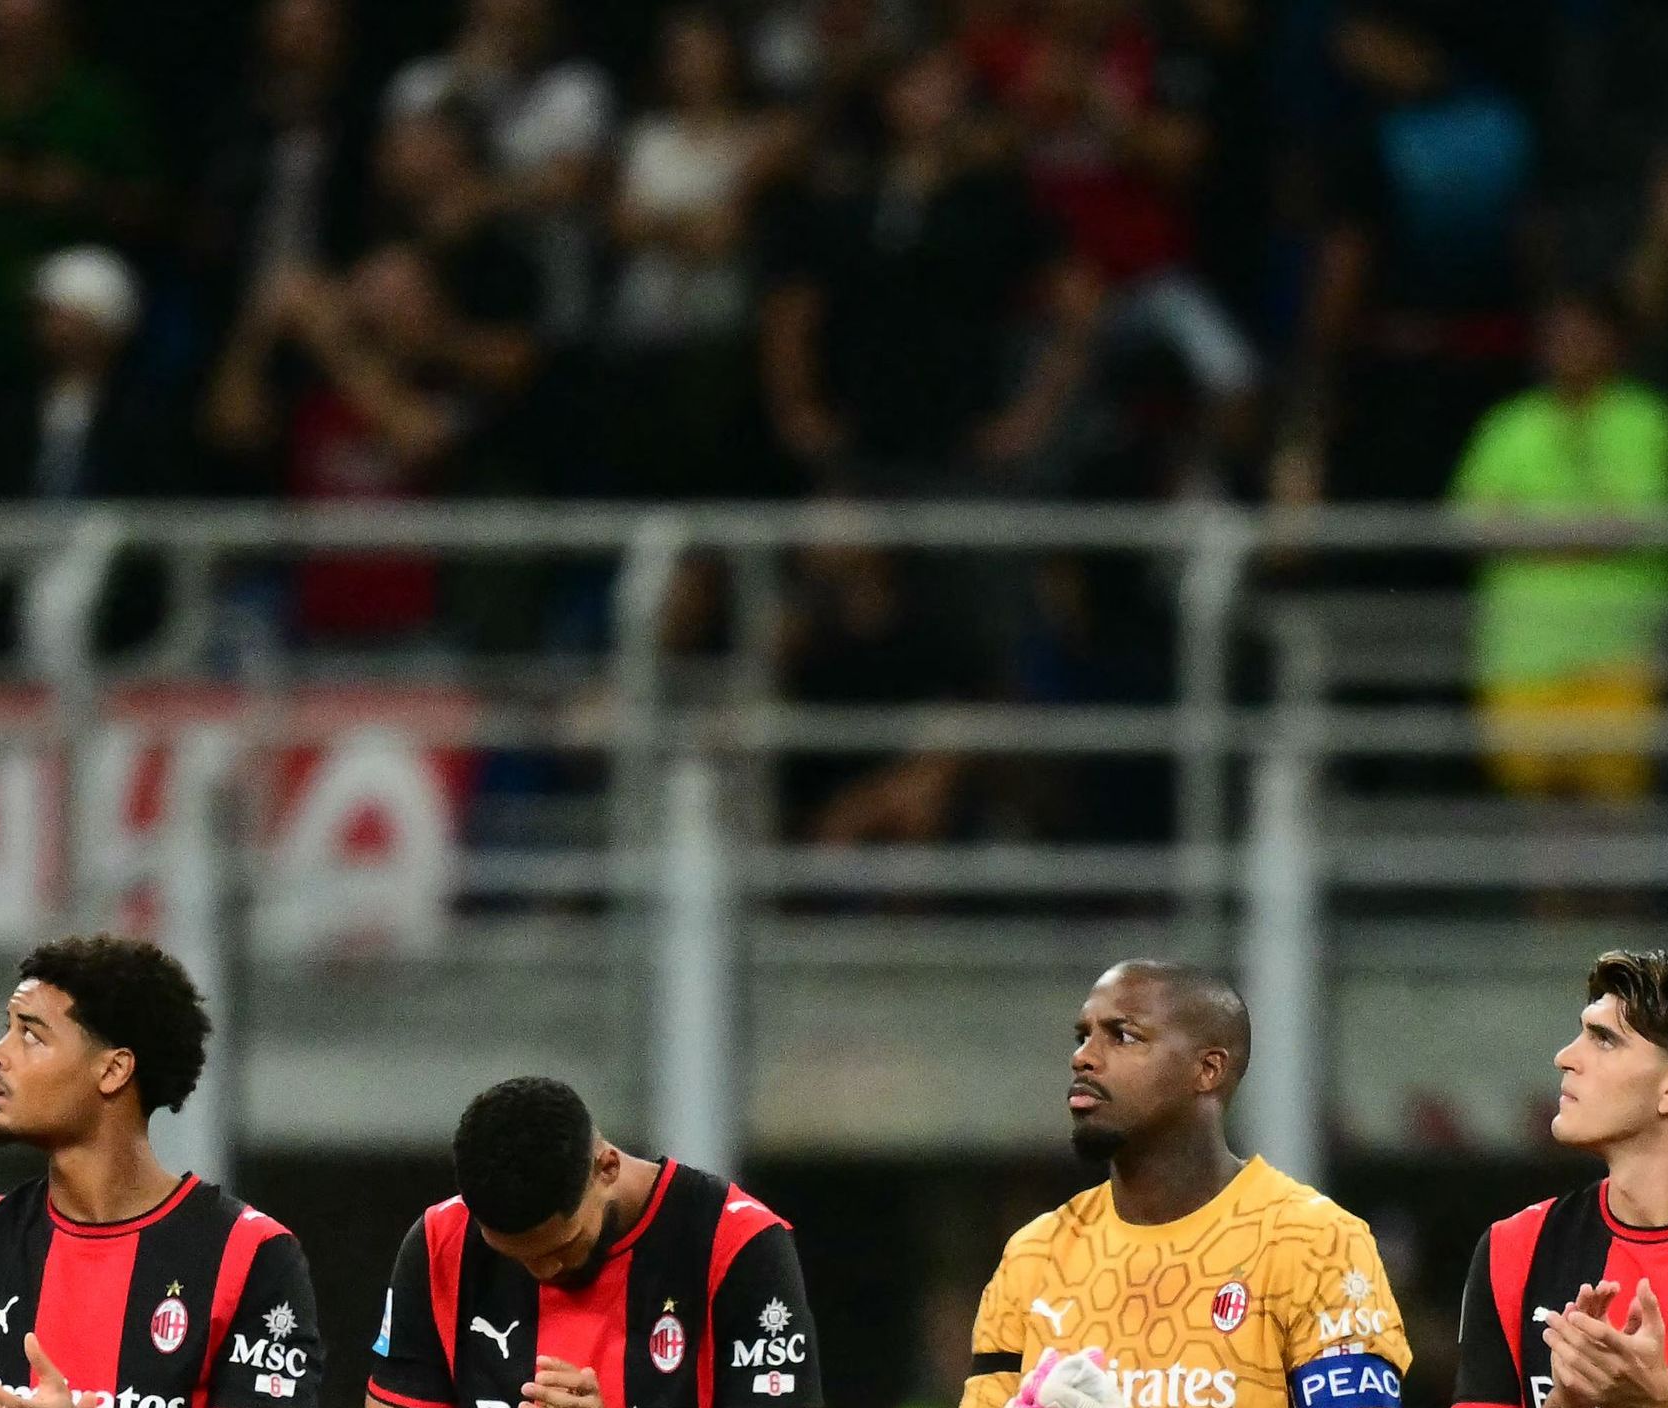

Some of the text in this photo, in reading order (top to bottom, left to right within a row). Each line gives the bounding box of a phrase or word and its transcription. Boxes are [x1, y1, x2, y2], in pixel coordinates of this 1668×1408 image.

[228, 1333, 308, 1378] MSC
[730, 1333, 806, 1369] MSC
[1300, 1366, 1401, 1407] PEAC
